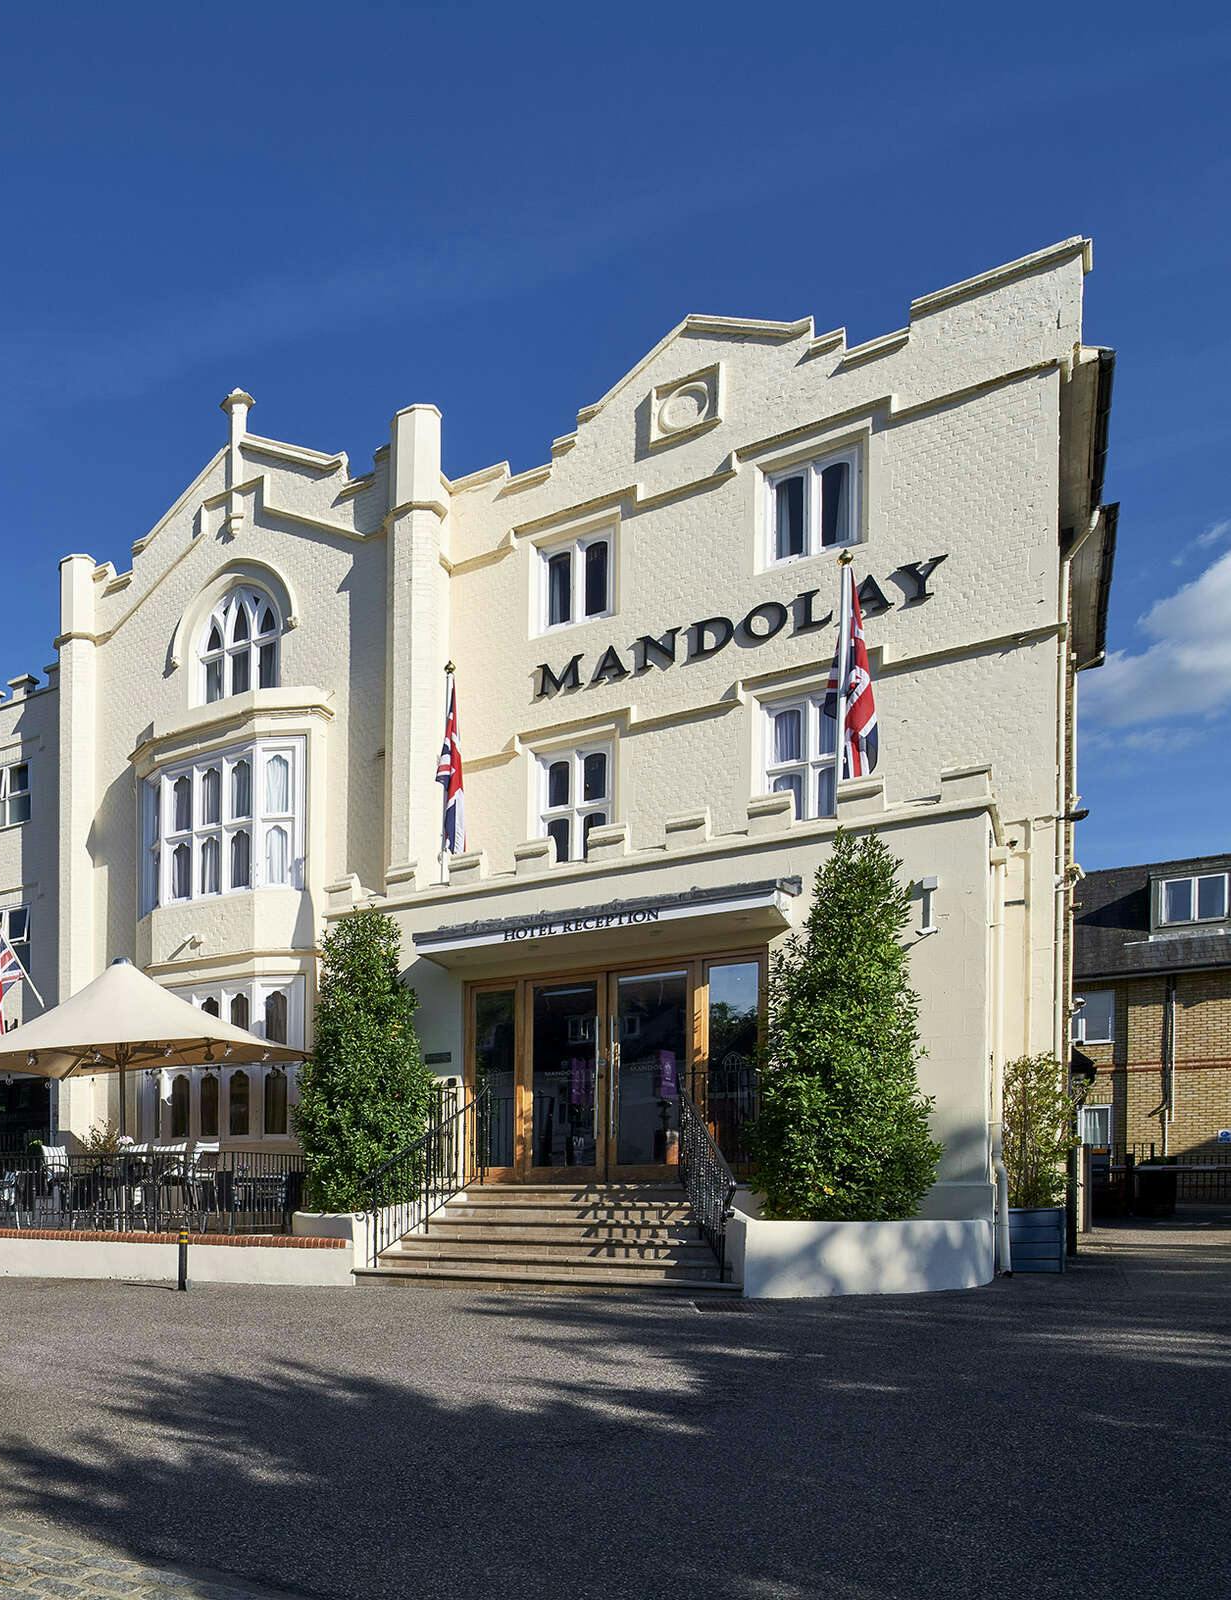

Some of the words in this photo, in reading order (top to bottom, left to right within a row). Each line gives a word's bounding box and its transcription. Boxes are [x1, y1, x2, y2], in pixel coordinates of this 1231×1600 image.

[535, 553, 949, 698] MANDOLAY
[503, 924, 557, 941] HOTEL
[563, 908, 660, 933] RECEPTION
